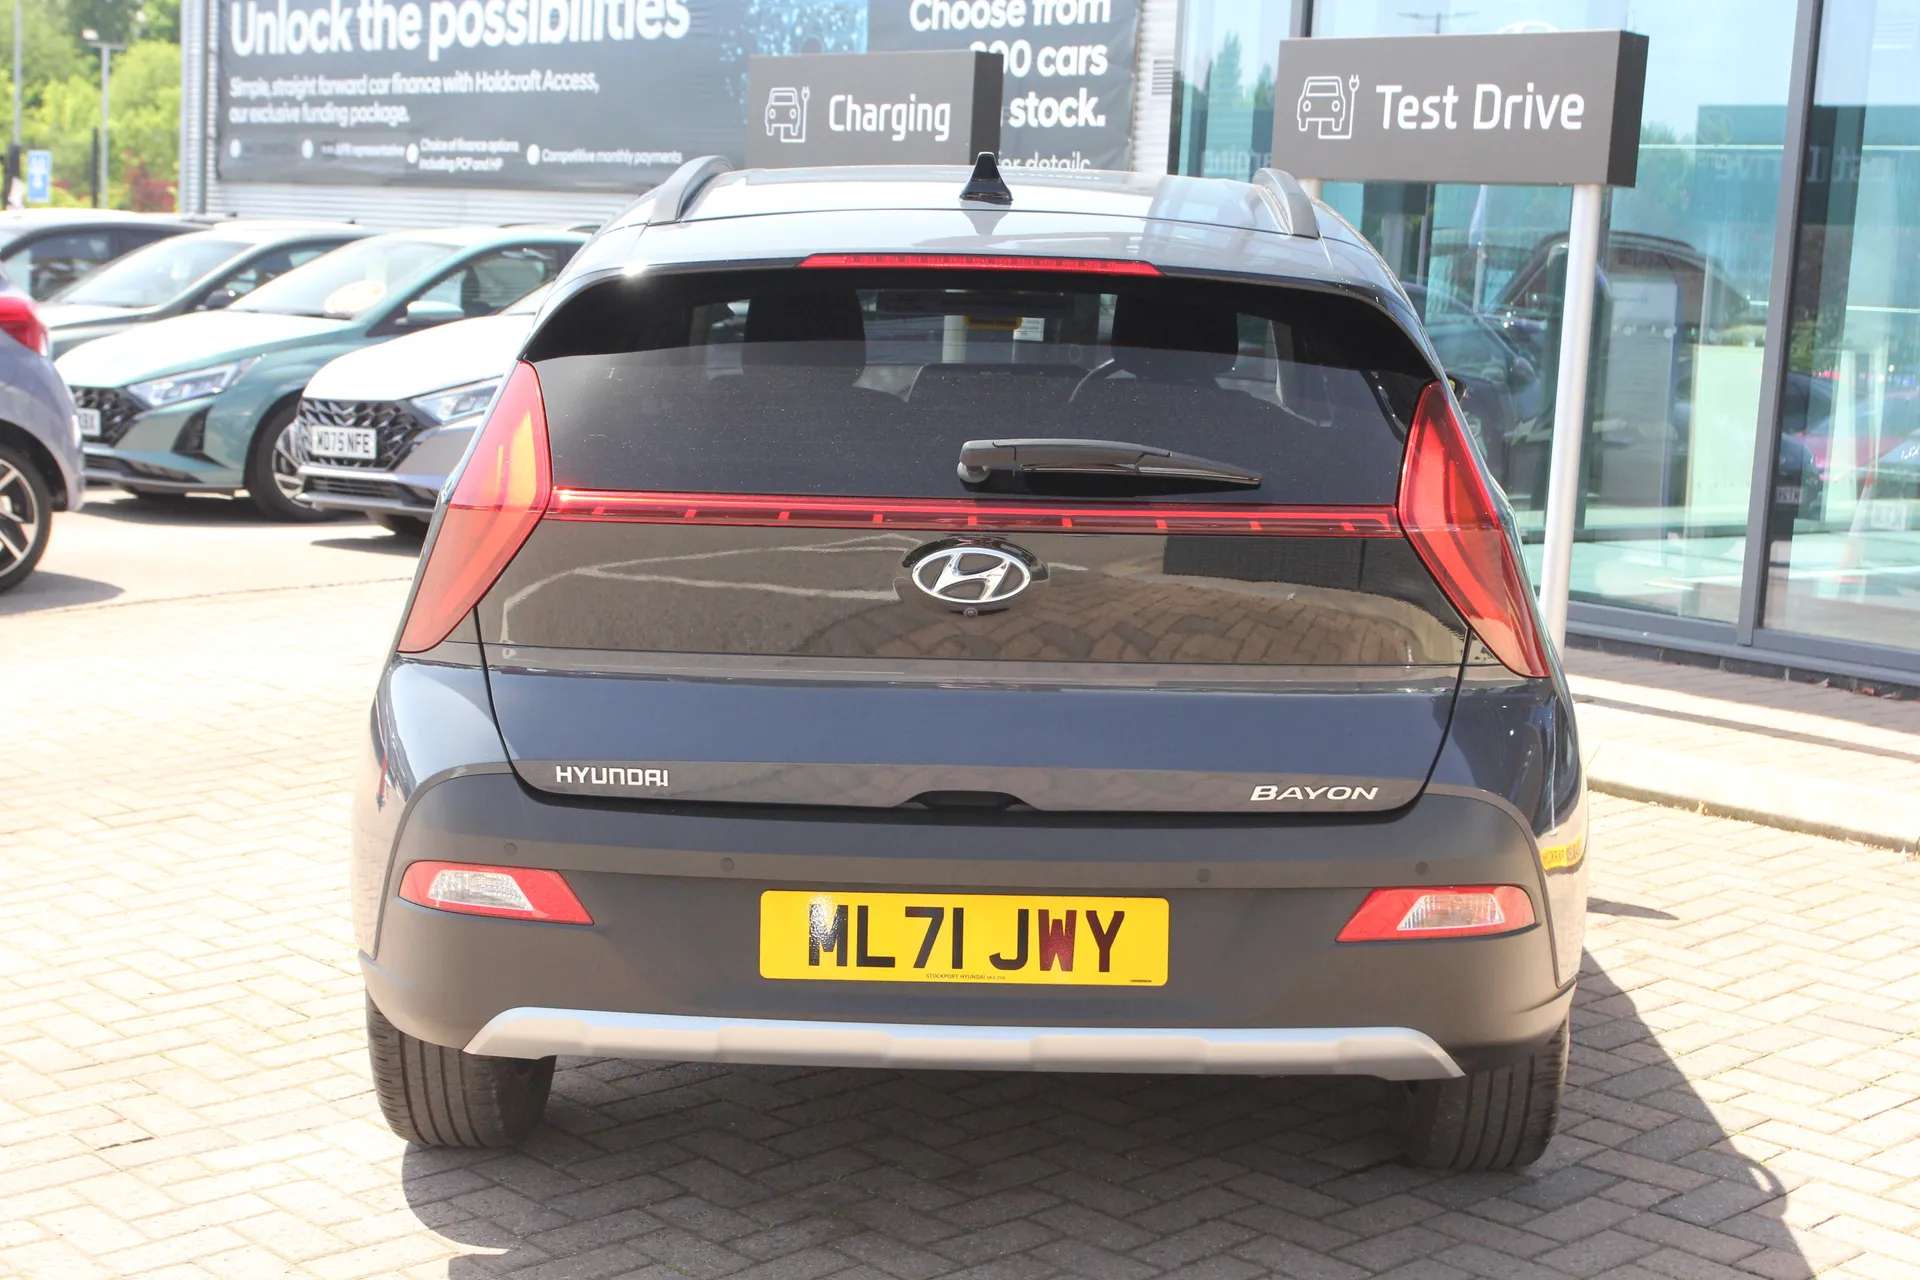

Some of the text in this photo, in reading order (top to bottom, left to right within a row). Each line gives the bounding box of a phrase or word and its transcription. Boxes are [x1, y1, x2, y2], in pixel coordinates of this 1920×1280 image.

[231, 0, 691, 61] Unlock the possibilities
[909, 0, 1111, 31] Choose from
[1037, 44, 1108, 77] cars
[318, 74, 369, 95] forward
[369, 77, 391, 95] car
[391, 72, 441, 95] finance
[443, 70, 473, 93] with
[475, 69, 541, 92] Holdcroft
[542, 70, 600, 94] Access,
[229, 101, 410, 127] our exclusive funding package.
[829, 93, 951, 141] Charging
[1008, 88, 1106, 128] stock.
[1376, 82, 1585, 130] Test Drive
[556, 765, 669, 787] HYUNDAI
[1250, 785, 1379, 801] BAYON
[808, 903, 1125, 972] ML71 JWY
